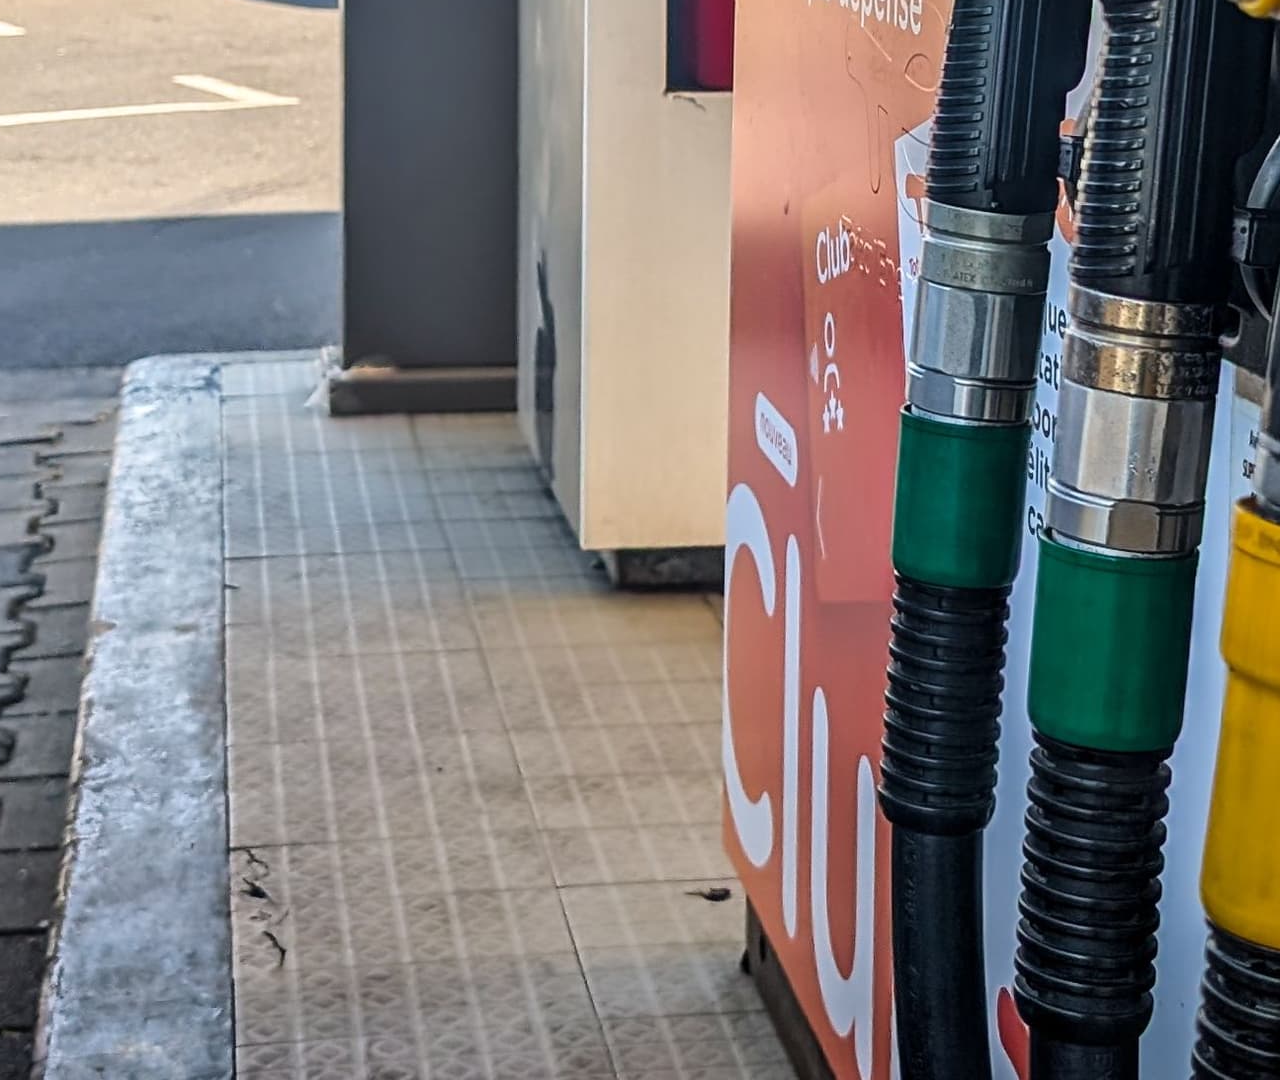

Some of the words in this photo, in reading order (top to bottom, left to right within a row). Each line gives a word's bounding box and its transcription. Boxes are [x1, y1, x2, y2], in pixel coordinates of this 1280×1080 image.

[816, 218, 851, 285] Club
[1044, 301, 1067, 340] ue
[1027, 440, 1051, 493] élit
[723, 482, 876, 1080] Clu
